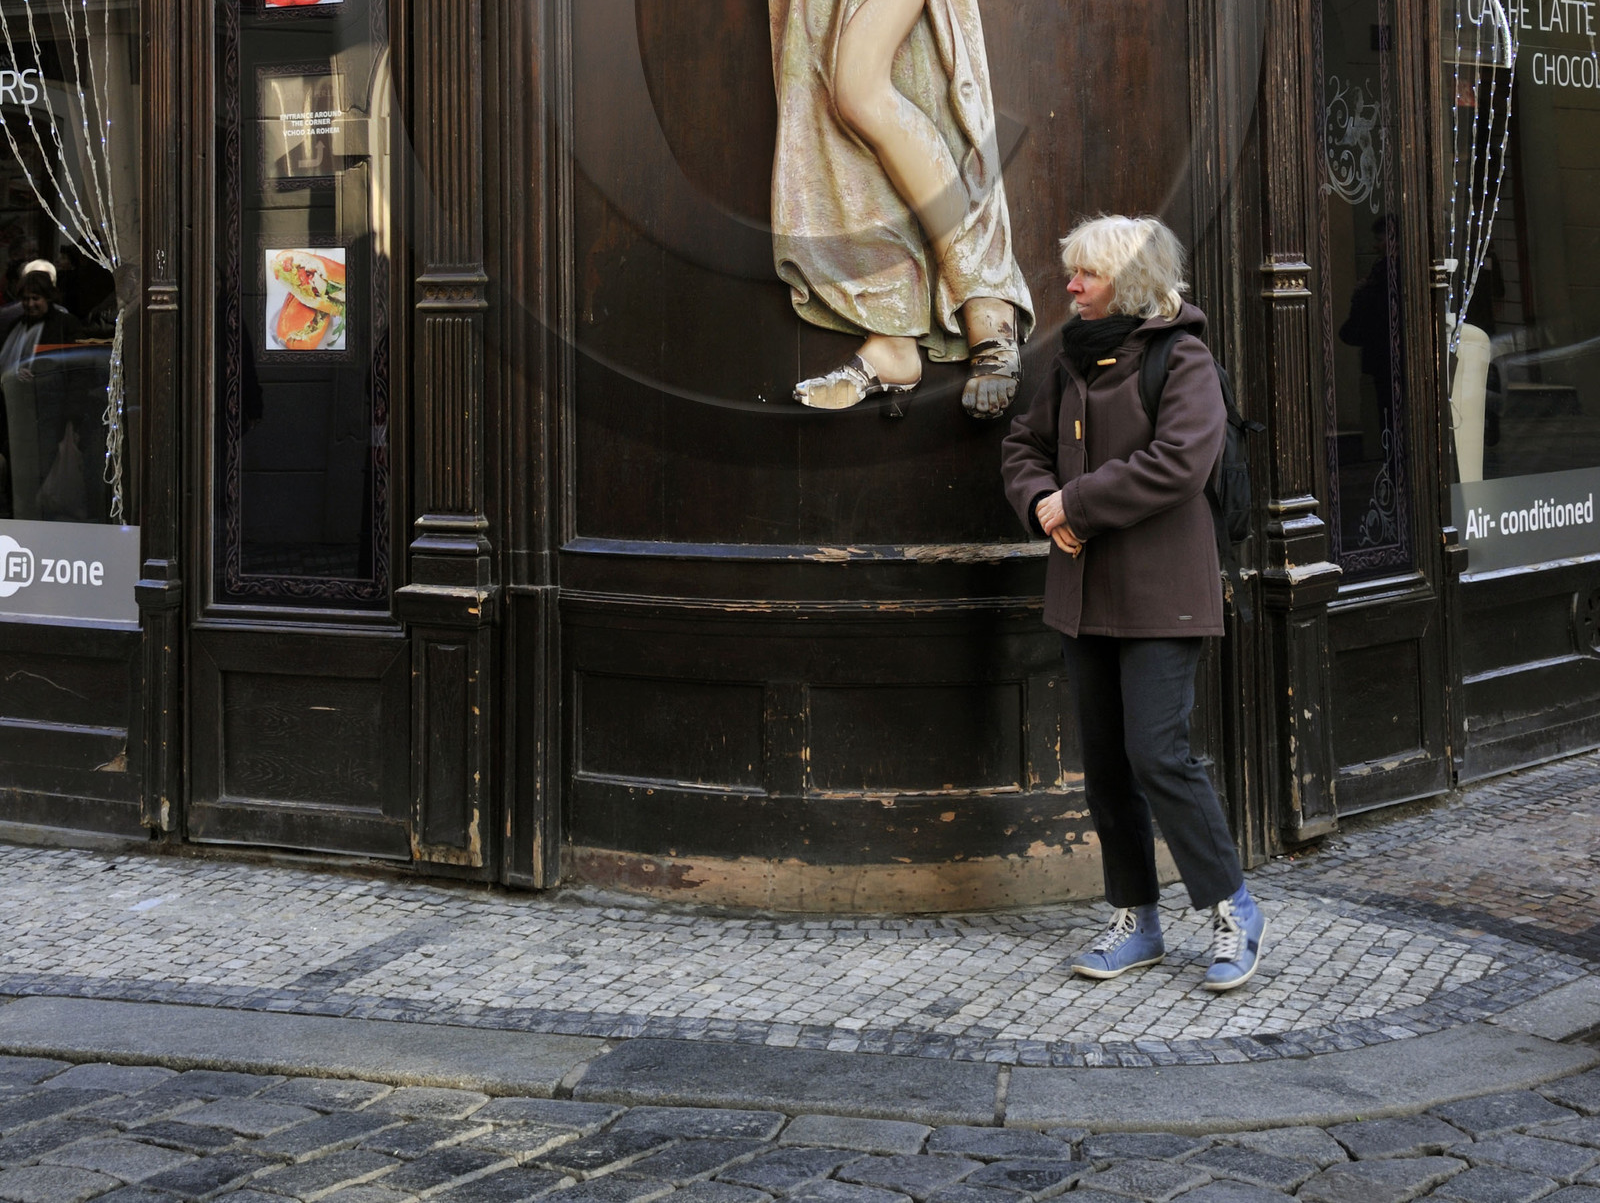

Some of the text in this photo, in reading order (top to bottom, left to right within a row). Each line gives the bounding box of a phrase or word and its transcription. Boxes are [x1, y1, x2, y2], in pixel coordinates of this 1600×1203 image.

[280, 112, 313, 120] ENTRANCE
[1500, 493, 1593, 535] conditioned
[41, 558, 104, 586] zone
